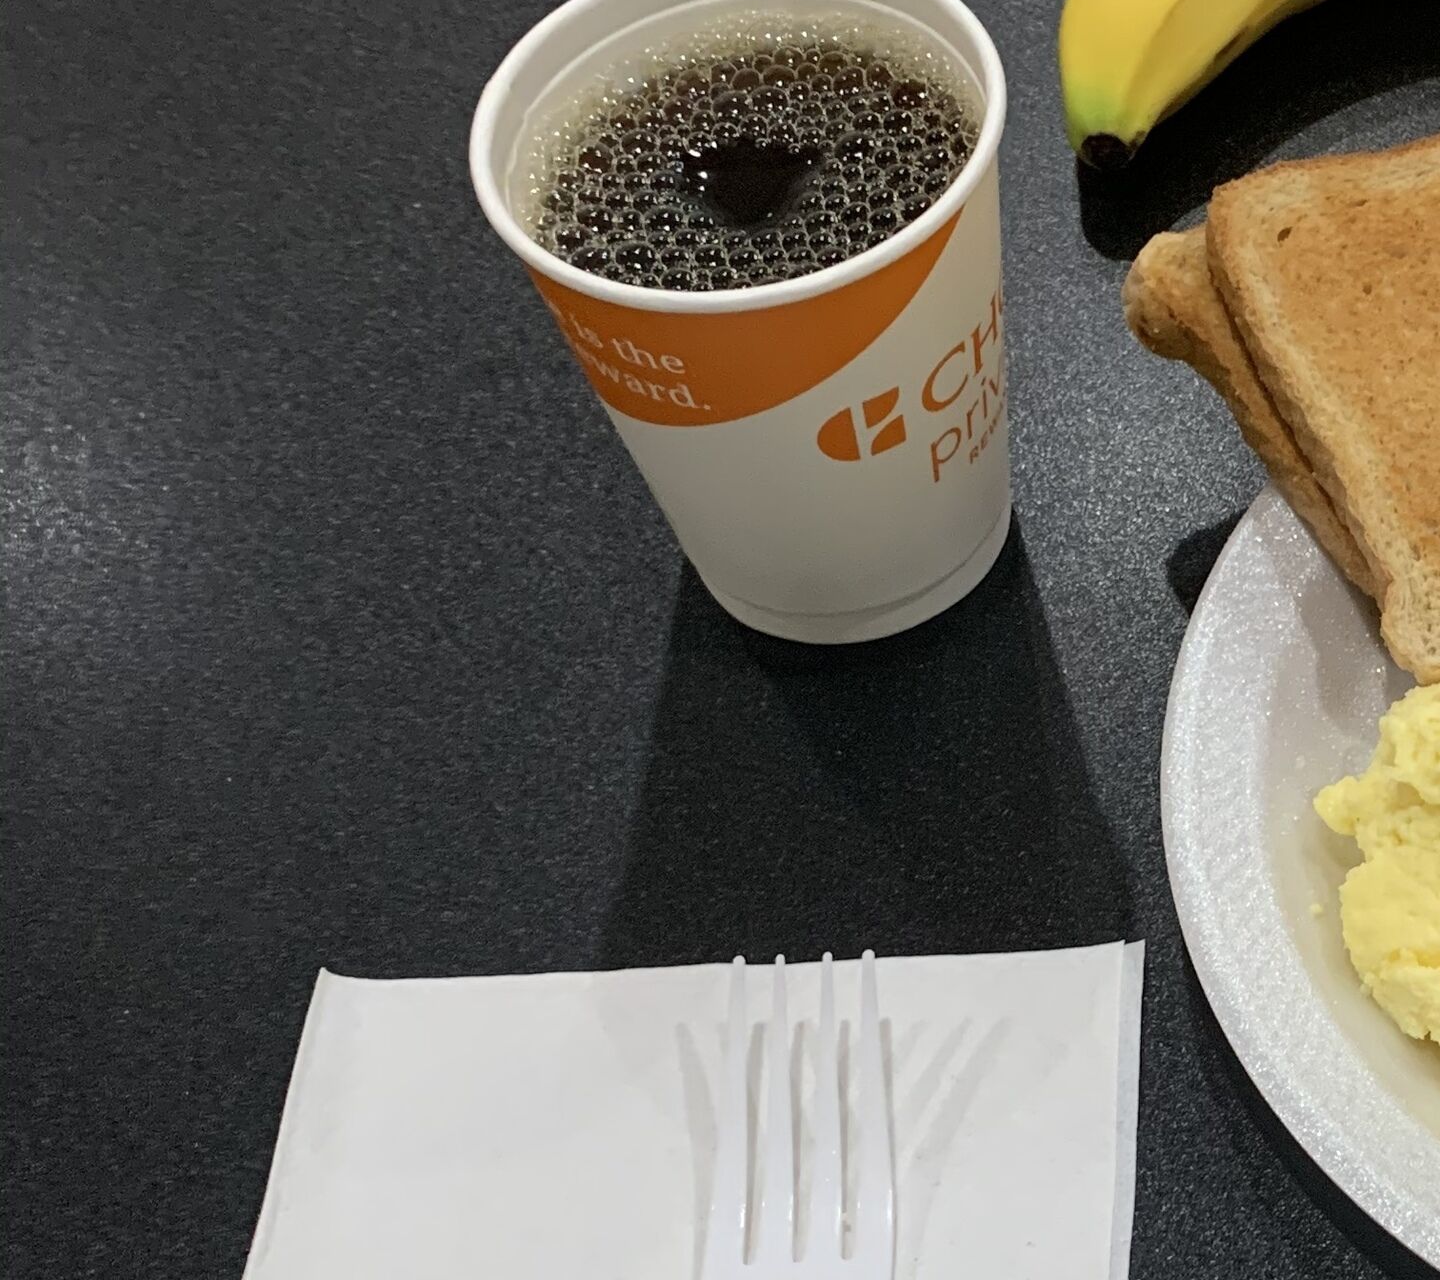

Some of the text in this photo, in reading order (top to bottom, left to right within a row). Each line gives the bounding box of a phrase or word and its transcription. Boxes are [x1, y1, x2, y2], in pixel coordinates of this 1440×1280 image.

[569, 312, 604, 349] is
[610, 337, 686, 375] the
[575, 344, 712, 411] ward.
